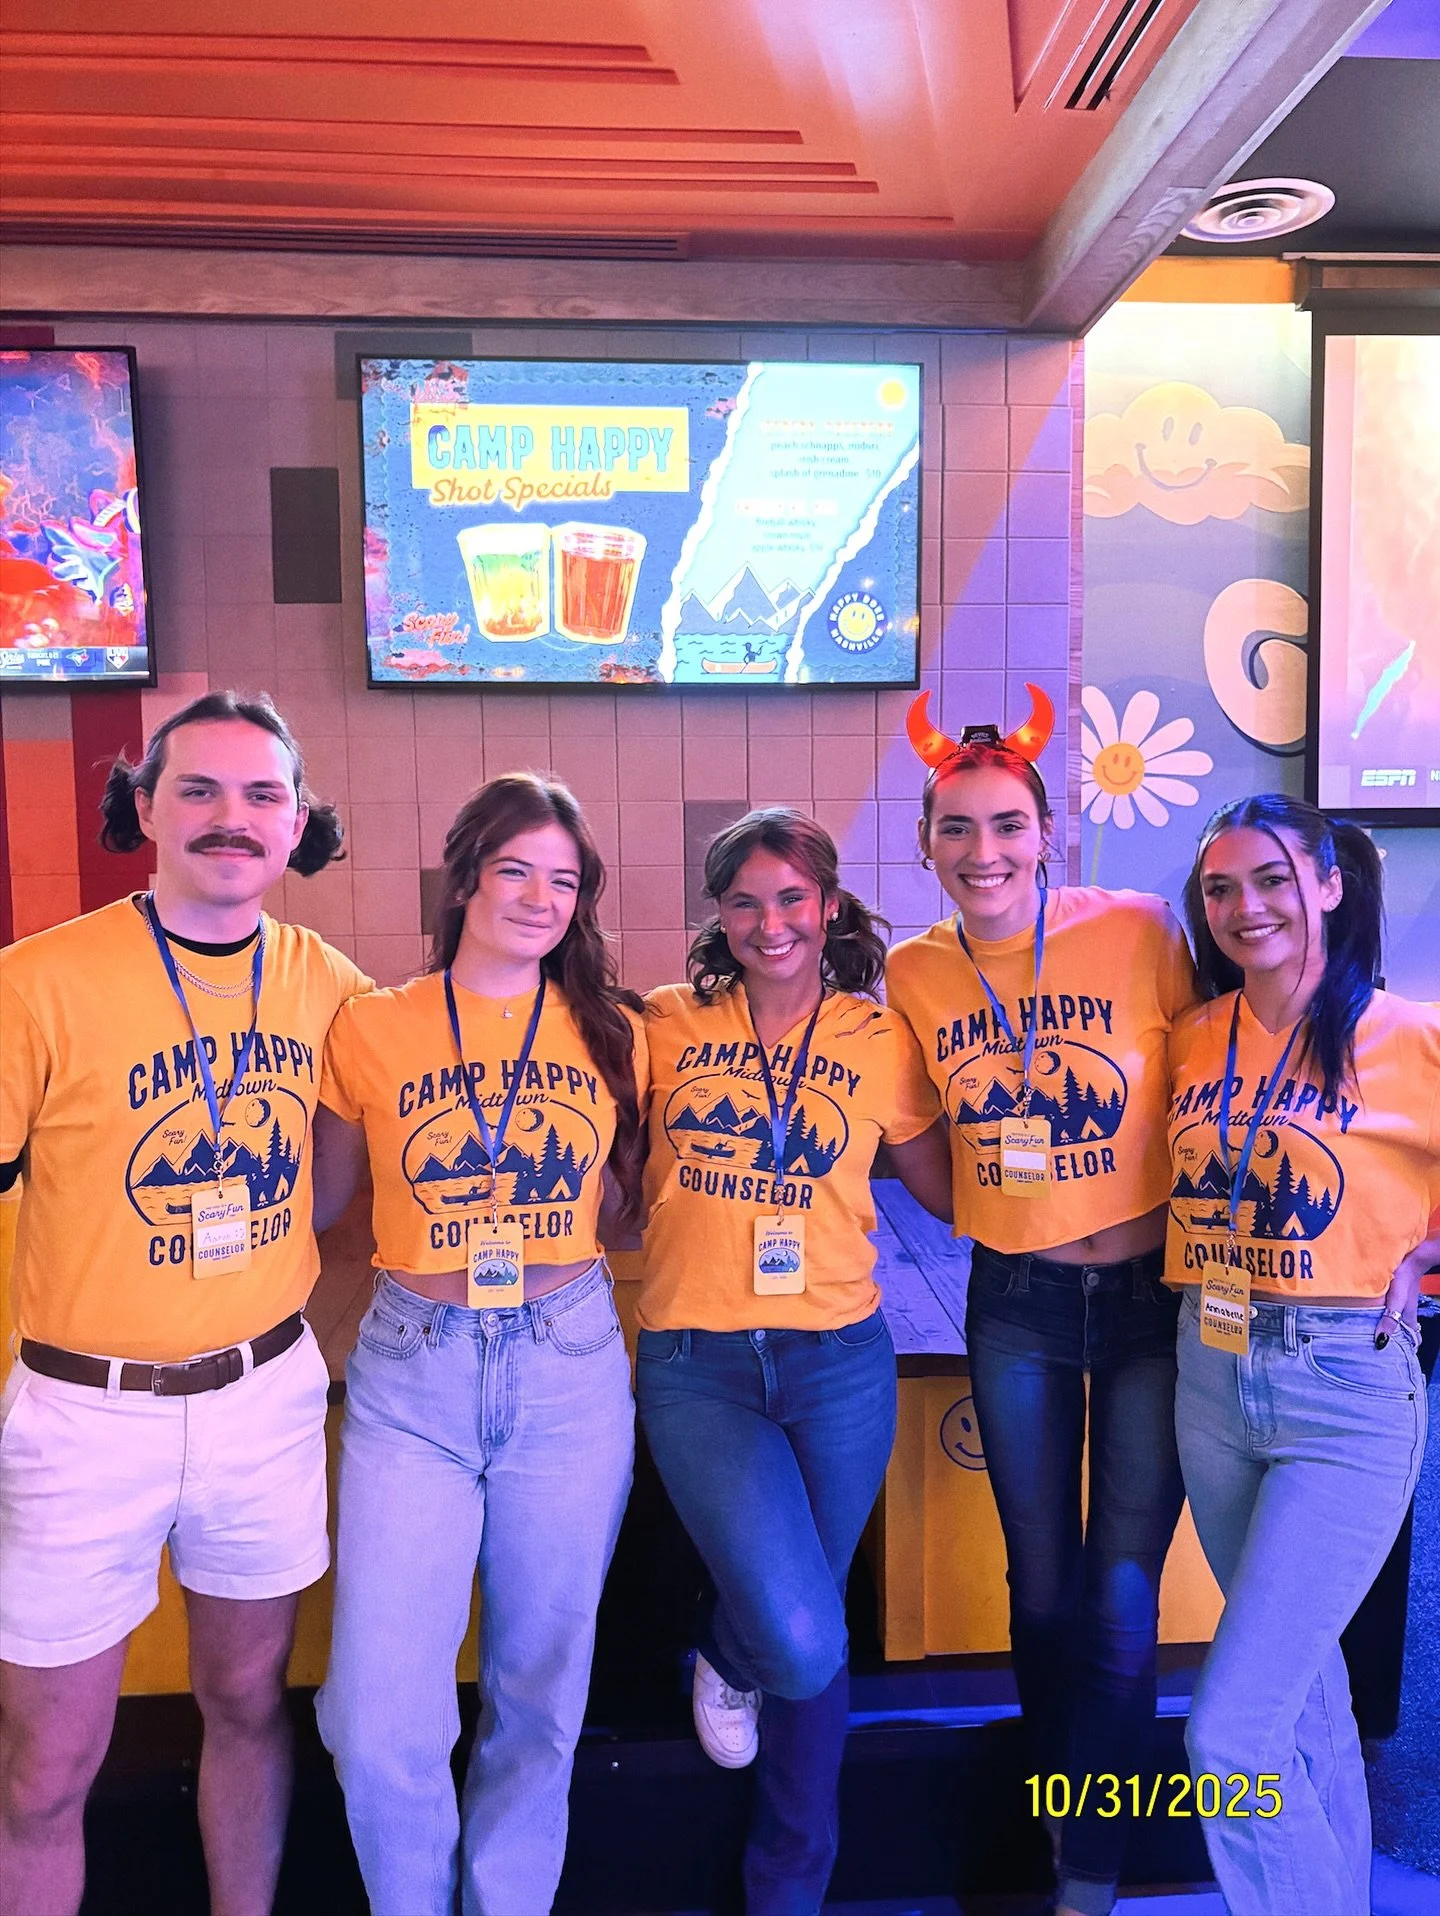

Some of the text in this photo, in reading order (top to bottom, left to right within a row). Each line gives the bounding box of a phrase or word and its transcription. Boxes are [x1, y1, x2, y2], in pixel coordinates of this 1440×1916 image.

[428, 425, 674, 472] CAMP HAPPY
[433, 471, 612, 508] Shot Specials
[829, 592, 859, 621] HAPPY
[1361, 769, 1416, 786] ESPN
[937, 994, 1113, 1062] CAMP HAPPY
[676, 1041, 760, 1073] CAMP
[982, 1034, 1063, 1057] Midtwn
[129, 1032, 314, 1110] CAMP HAPPY
[191, 1078, 276, 1102] Mdtown
[398, 1059, 598, 1118] CAMP HAPPY
[455, 1092, 549, 1110] Midtwn
[1251, 1075, 1359, 1134] HAPPY
[1201, 1110, 1288, 1127] Mdtwn
[1004, 1134, 1045, 1147] Scary Fun
[977, 1147, 1117, 1187] COELOR
[1004, 1170, 1045, 1181] COUNSELOR
[679, 1165, 813, 1209] COUNSELOR
[198, 1209, 226, 1223] Scary
[226, 1203, 244, 1216] Fun
[149, 1207, 291, 1265] COELOR
[430, 1210, 573, 1249] COELOR
[198, 1243, 245, 1260] COUNSELOR
[473, 1248, 519, 1263] CAMP HAPPY
[758, 1238, 801, 1252] CAMP HAPPY
[1184, 1241, 1313, 1279] COUNSELOR
[1205, 1279, 1230, 1295] Scary
[1229, 1283, 1244, 1296] Fun
[1205, 1302, 1244, 1321] Annabelle
